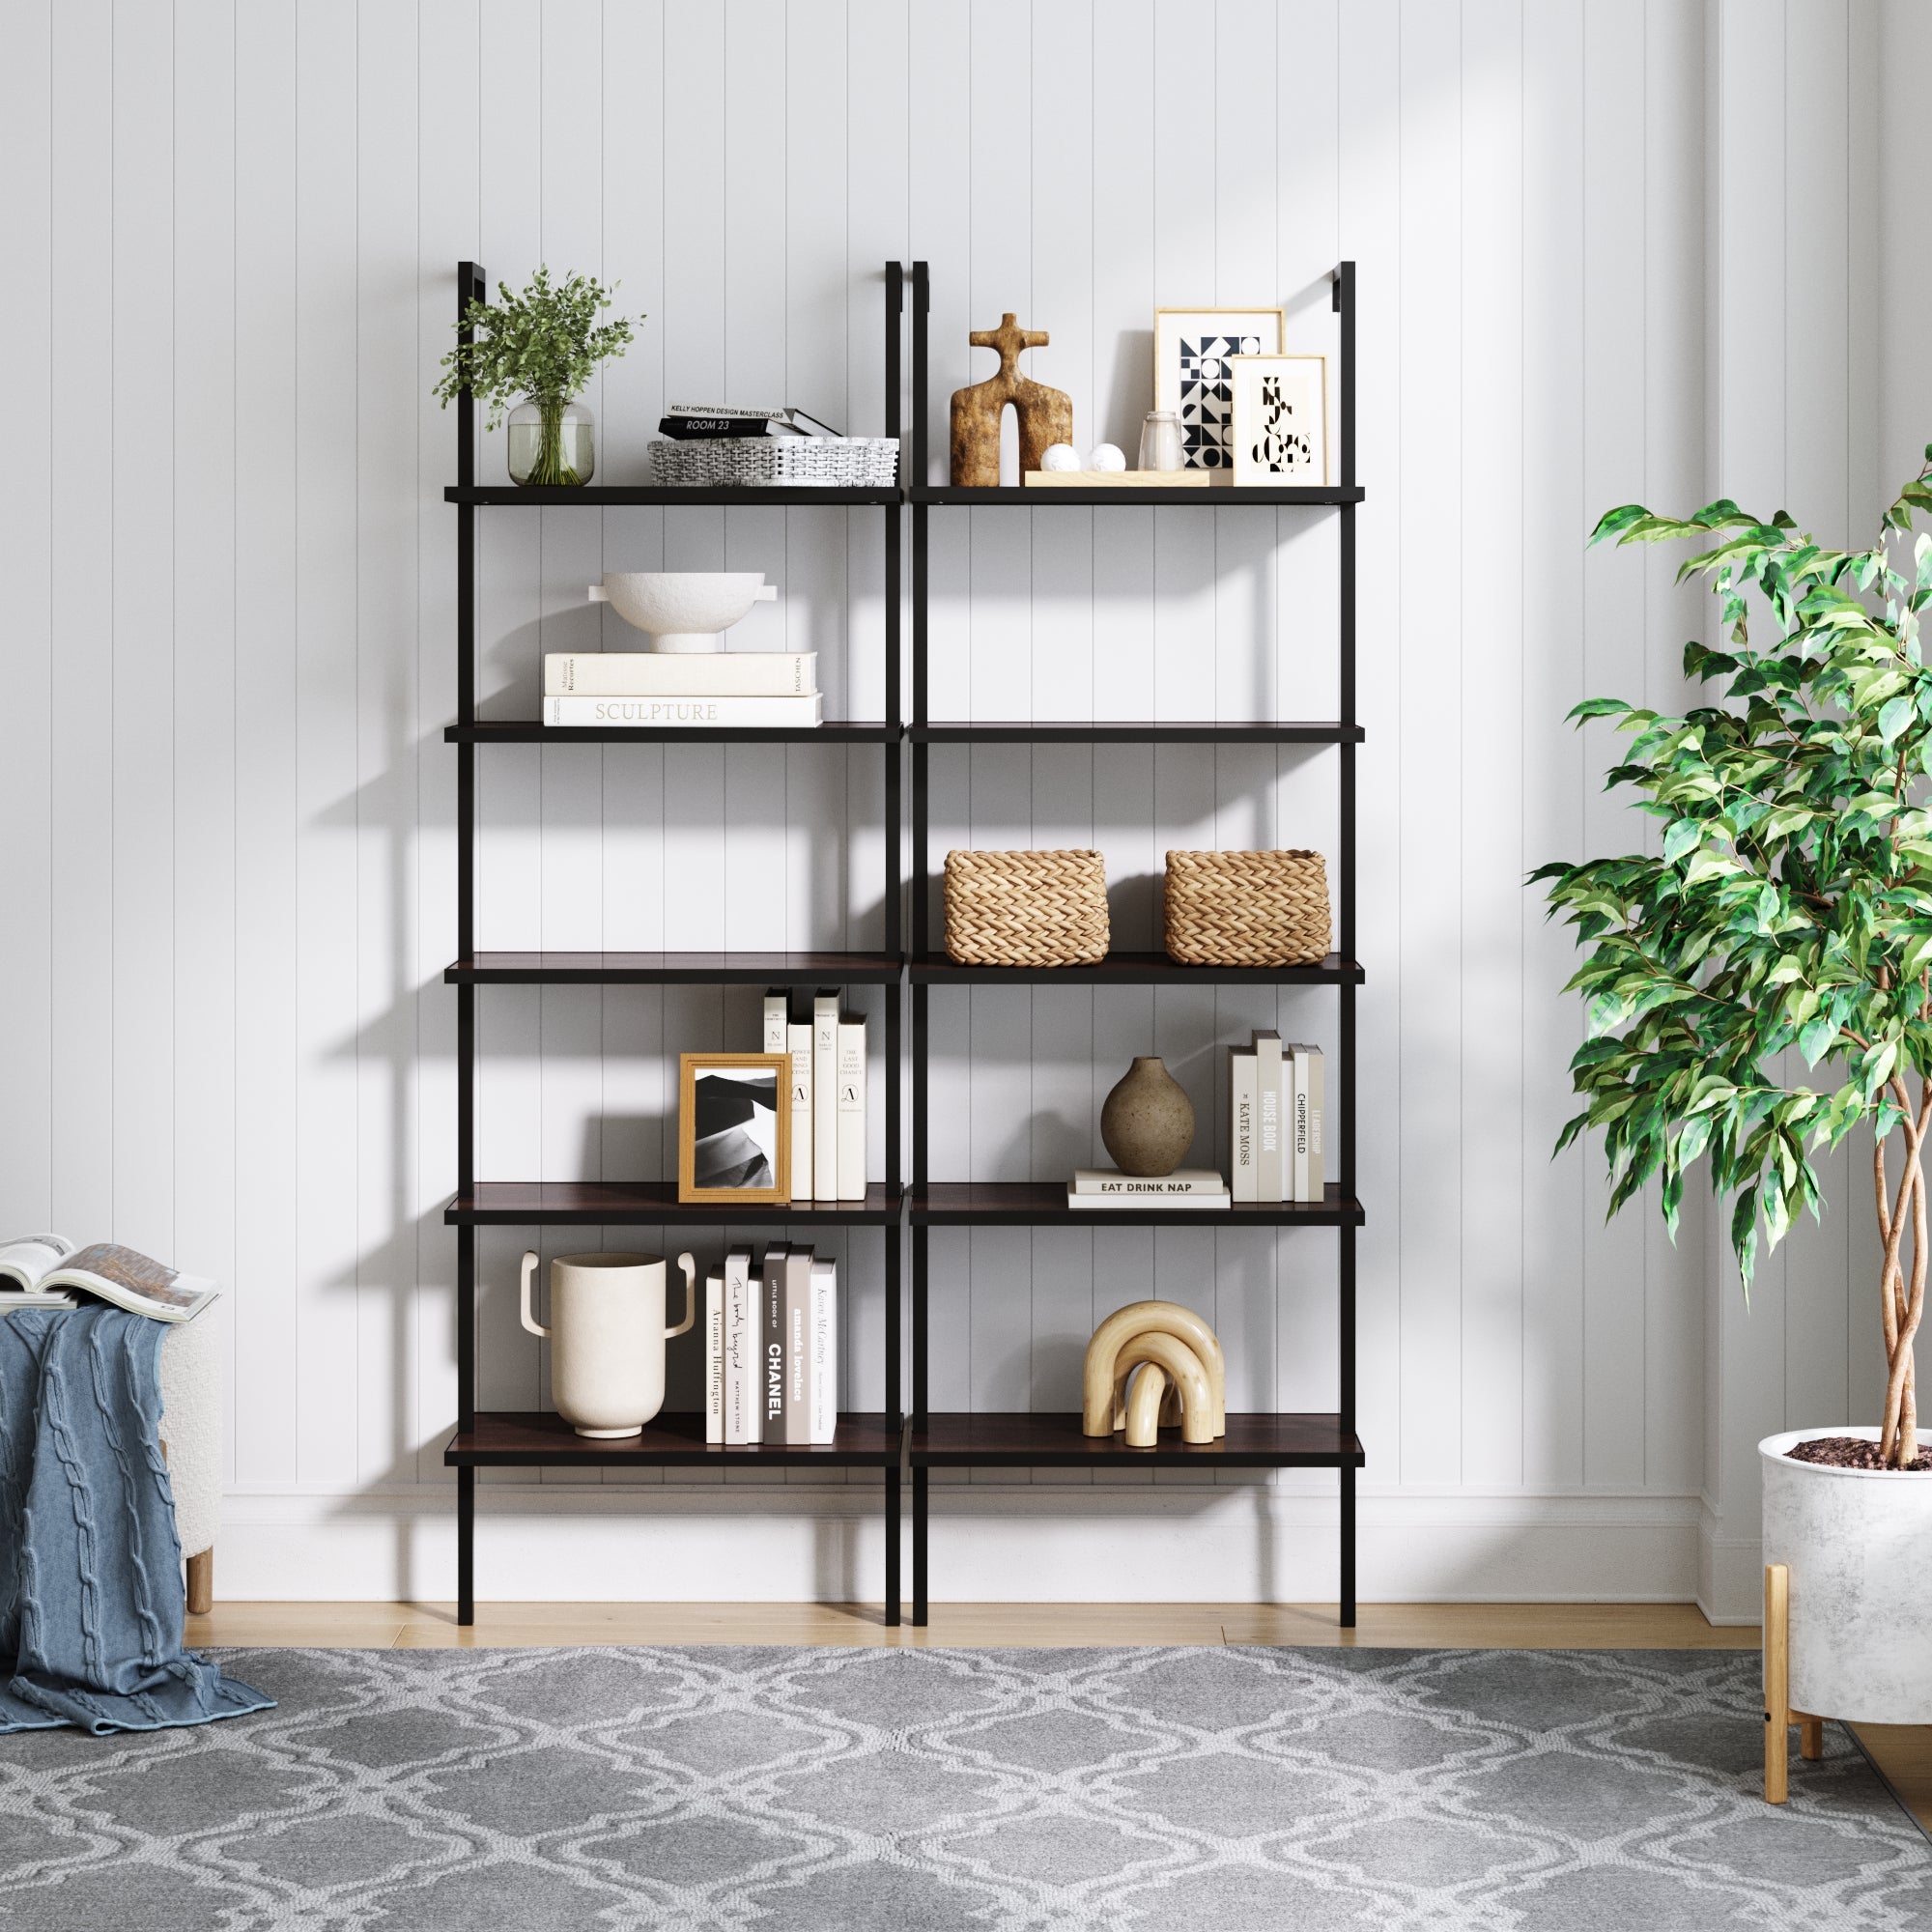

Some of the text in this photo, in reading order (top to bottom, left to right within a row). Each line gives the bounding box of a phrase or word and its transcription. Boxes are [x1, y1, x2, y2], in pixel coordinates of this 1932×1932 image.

[686, 421, 716, 430] ROOM
[718, 421, 730, 430] 23
[691, 406, 715, 414] HOPPEN
[739, 410, 783, 419] MASTERCLASS
[596, 703, 718, 720] SCULPTURE
[1240, 1103, 1250, 1166] KATE MOSS
[1263, 1091, 1277, 1151] HOUSE BOOK
[1298, 1093, 1306, 1154] CHIPPERFIELD
[1312, 1110, 1321, 1154] LEADERSHIP
[1101, 1183, 1192, 1192] EAT DRINK NAP
[818, 1288, 827, 1314] Karen
[772, 1320, 777, 1328] OF
[817, 1317, 827, 1364] McCartney
[710, 1309, 722, 1414] Arianna Huffington
[794, 1308, 803, 1401] amanda lovelace
[768, 1343, 781, 1420] CHANEL
